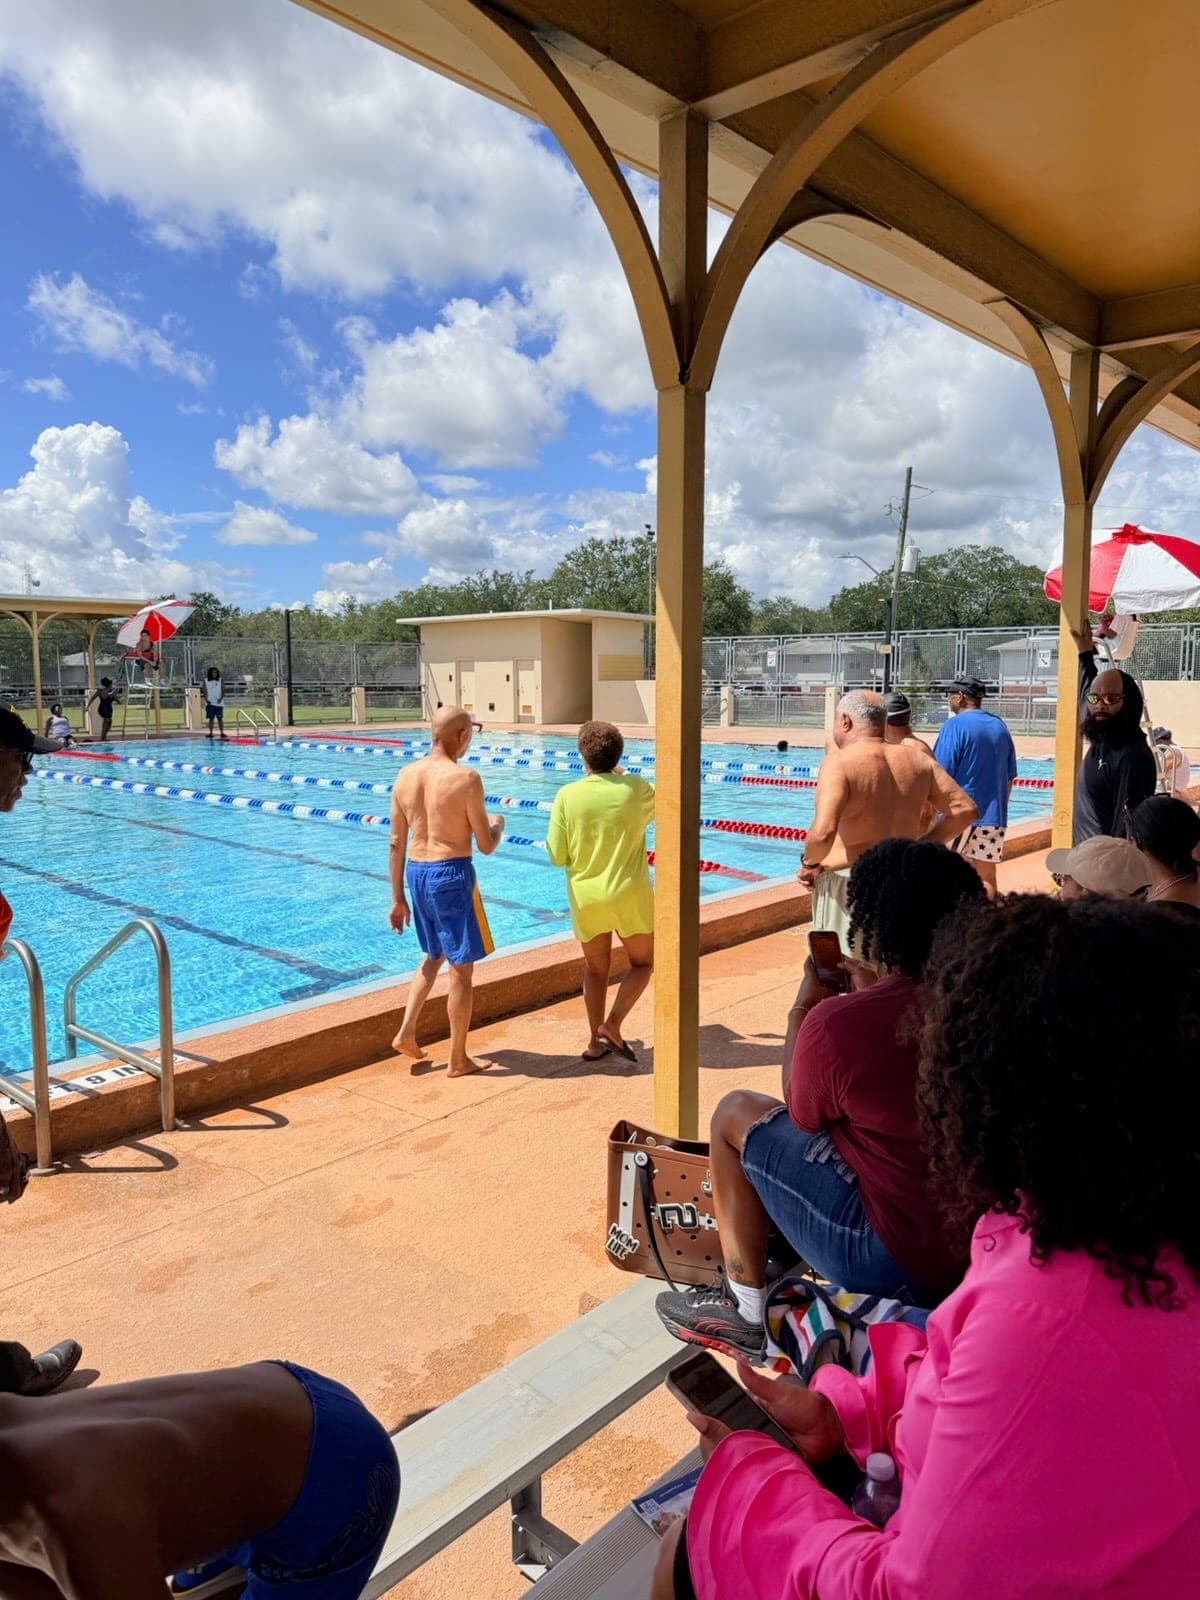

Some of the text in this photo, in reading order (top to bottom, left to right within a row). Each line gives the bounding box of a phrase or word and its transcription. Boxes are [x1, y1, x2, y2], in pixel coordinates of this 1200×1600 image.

[85, 1075, 106, 1085] 9
[607, 1238, 626, 1258] LIFE
[609, 1225, 638, 1252] MOM
